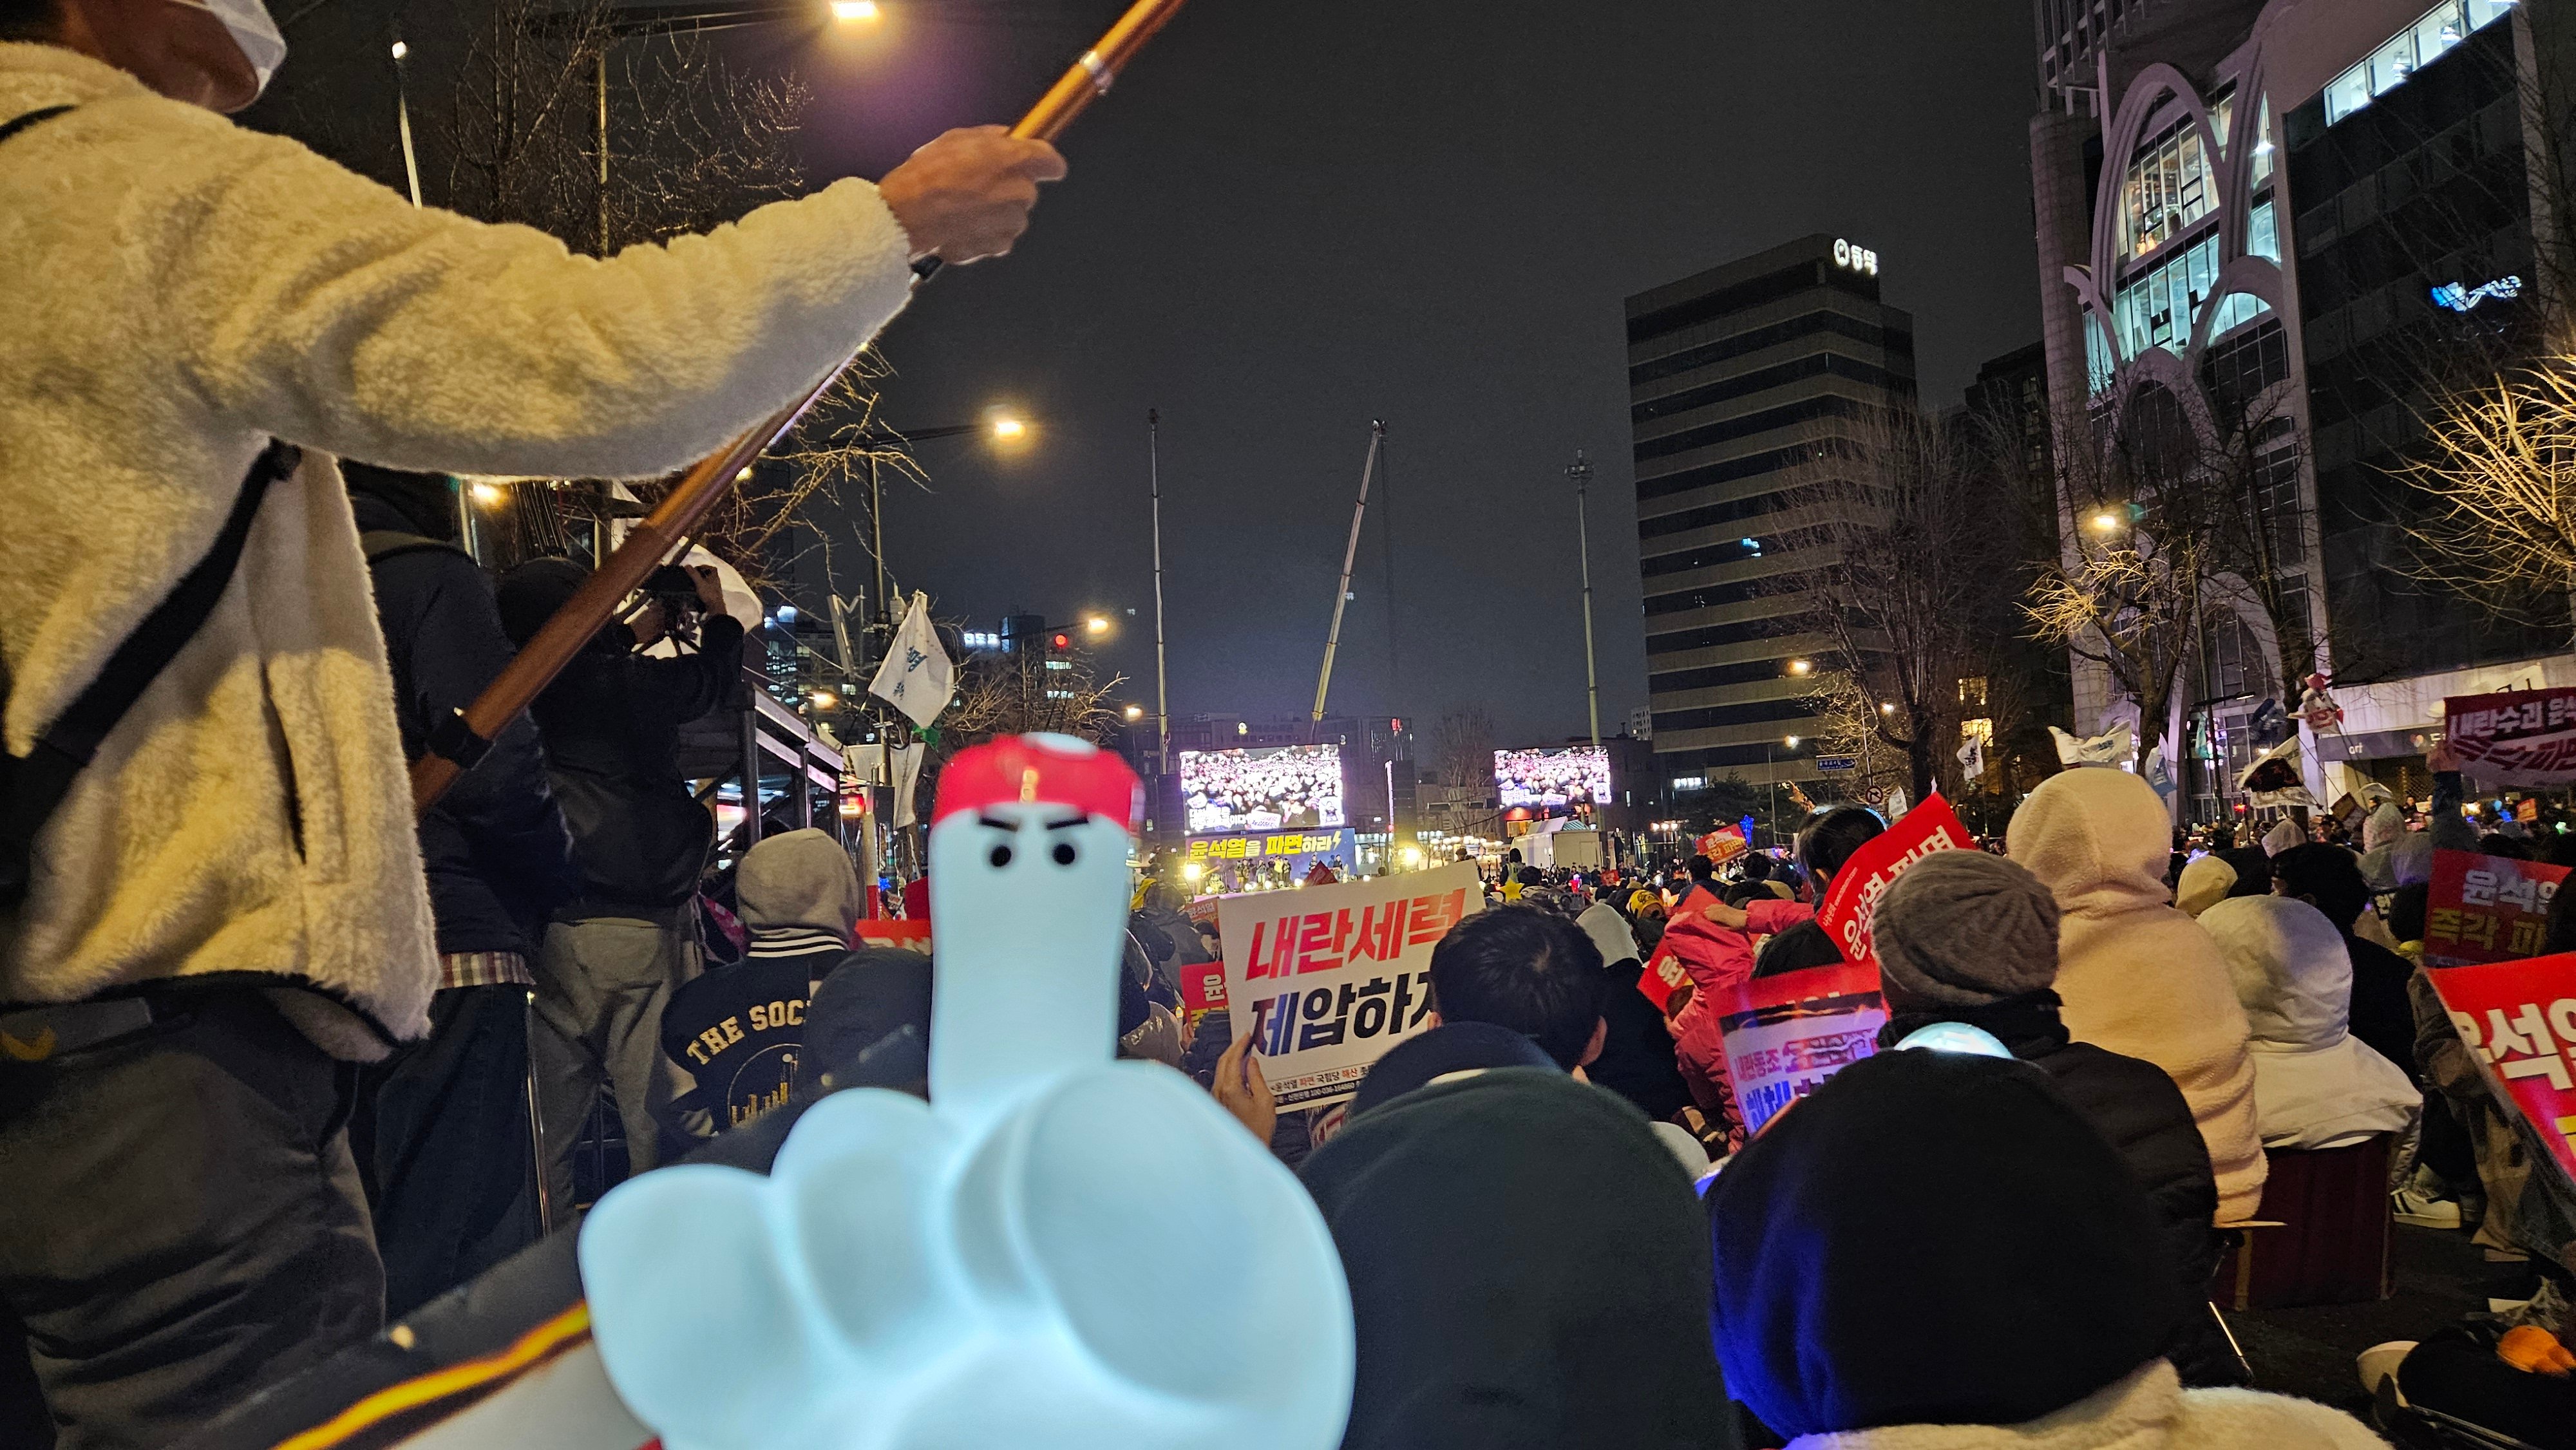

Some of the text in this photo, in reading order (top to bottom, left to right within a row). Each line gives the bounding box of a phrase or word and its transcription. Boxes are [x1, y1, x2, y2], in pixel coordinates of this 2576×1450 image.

[1189, 833, 1332, 860] 윤석열을 파면하라
[1245, 888, 1466, 981] 내란세력
[686, 999, 811, 1066] THE SOC
